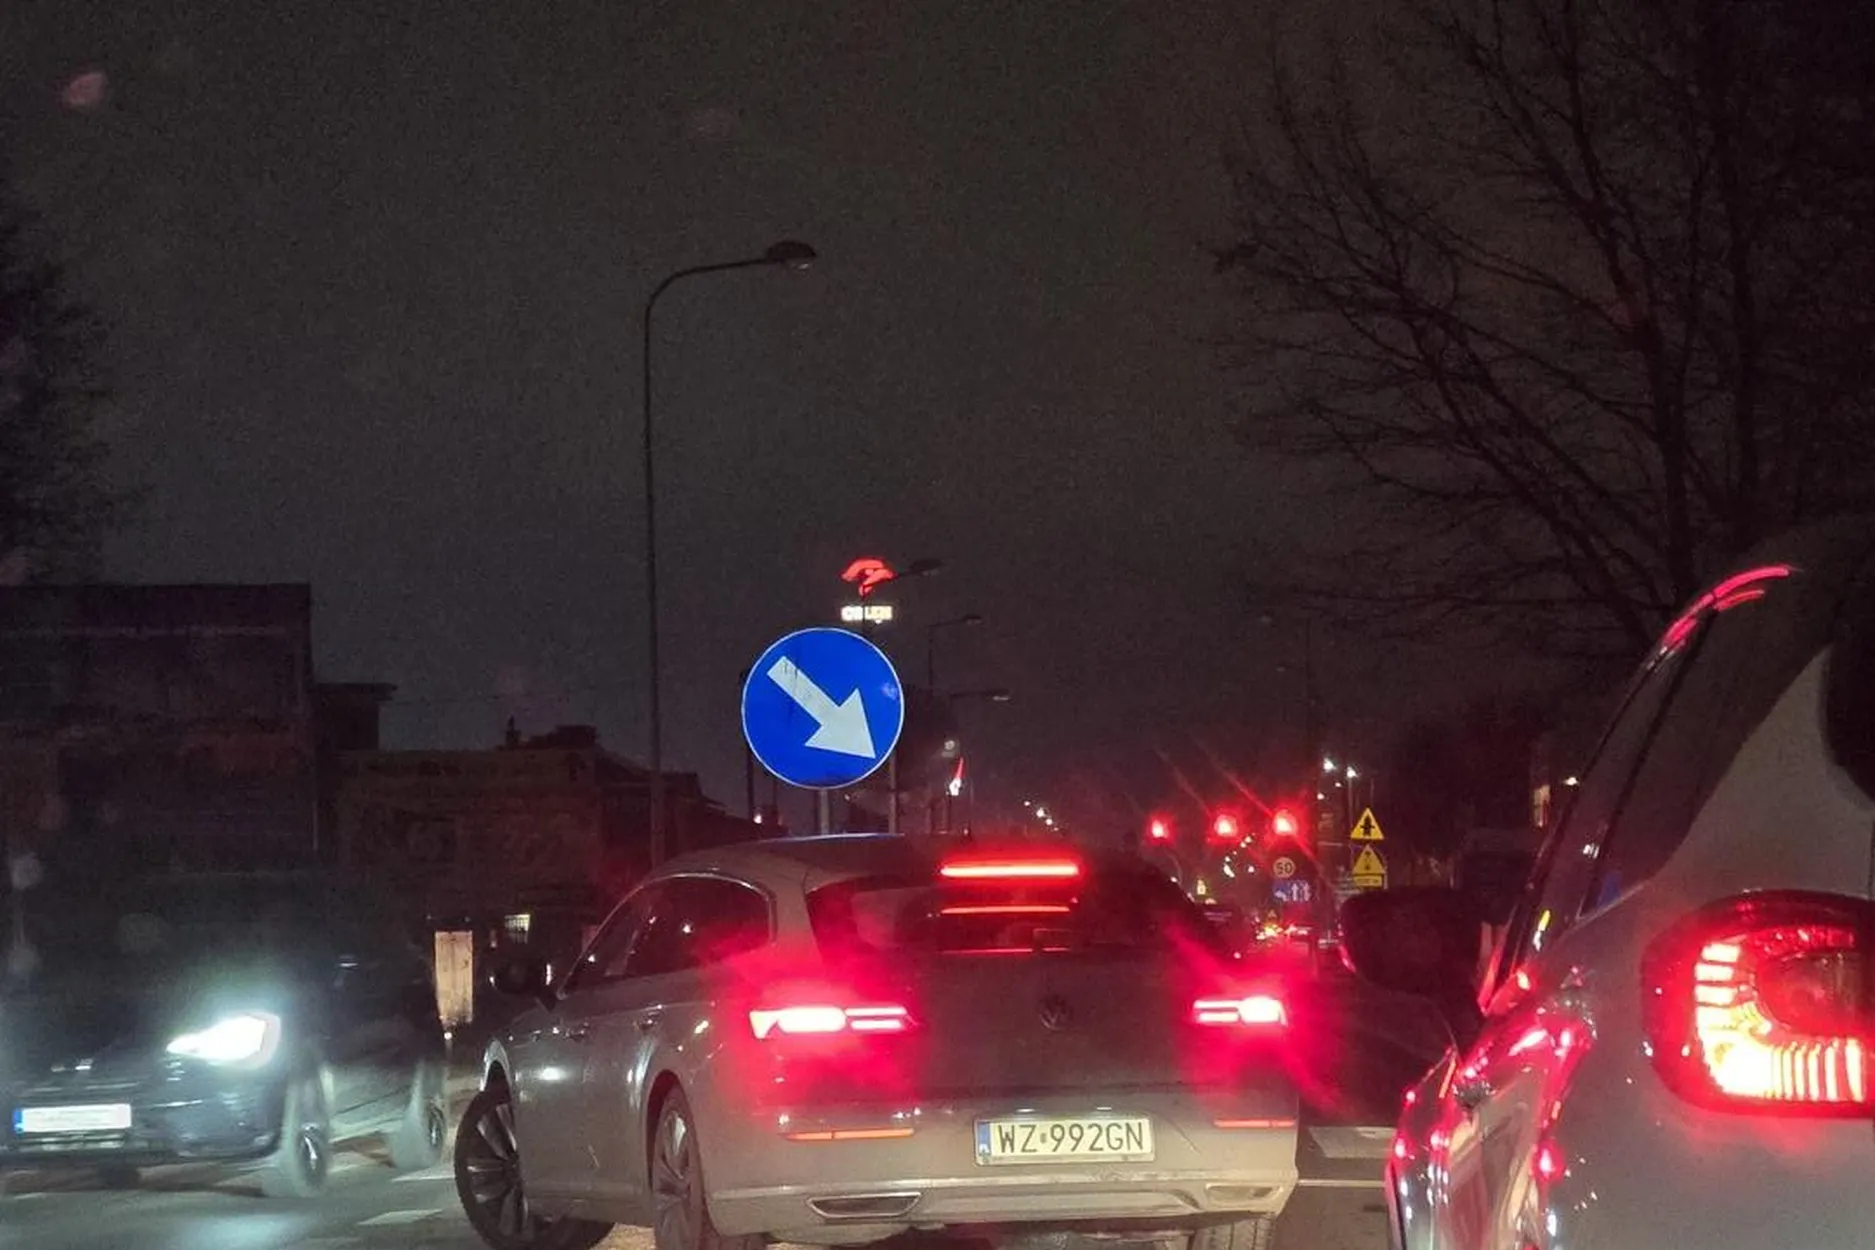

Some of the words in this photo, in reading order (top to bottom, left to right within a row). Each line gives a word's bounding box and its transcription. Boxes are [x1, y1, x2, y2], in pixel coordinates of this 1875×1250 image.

[1276, 862, 1293, 875] 50
[998, 1124, 1037, 1153] WZ
[1050, 1122, 1144, 1152] 992GN
